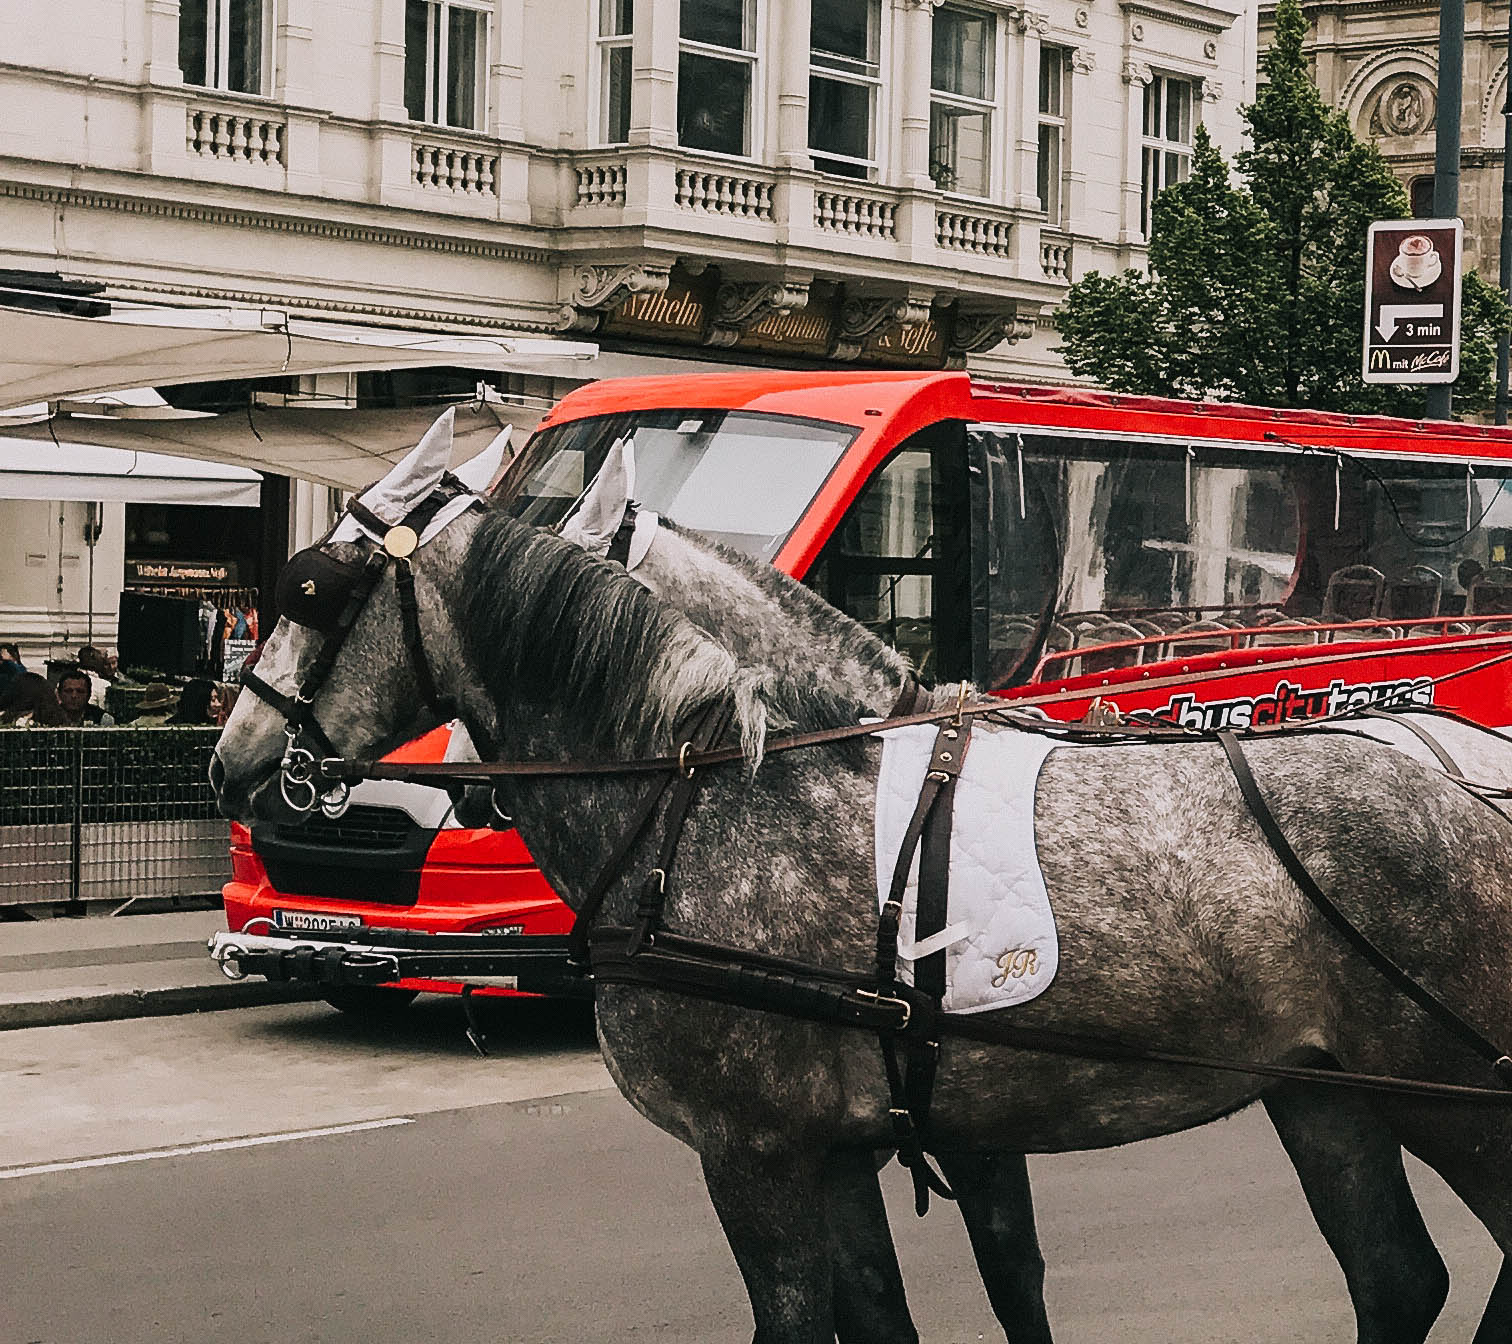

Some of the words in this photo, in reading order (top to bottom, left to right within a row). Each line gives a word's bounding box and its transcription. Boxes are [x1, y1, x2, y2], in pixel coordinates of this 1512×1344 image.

[752, 315, 831, 342] ungmann
[1405, 323, 1414, 337] 3
[1417, 323, 1441, 336] min
[1392, 359, 1409, 369] mit
